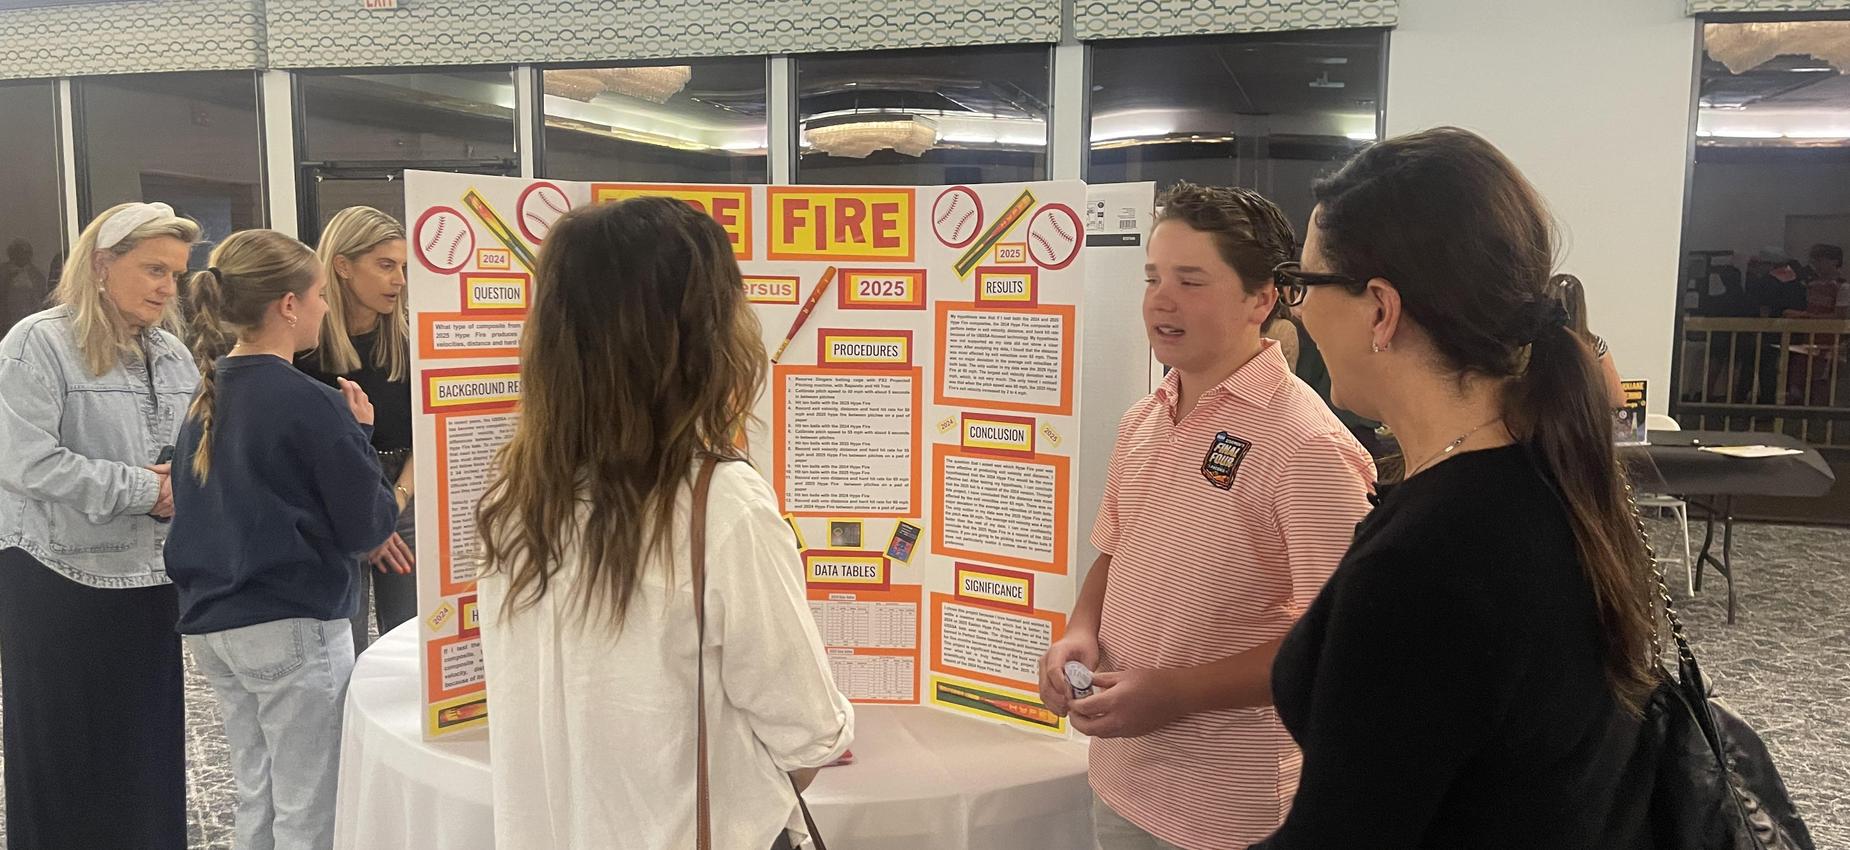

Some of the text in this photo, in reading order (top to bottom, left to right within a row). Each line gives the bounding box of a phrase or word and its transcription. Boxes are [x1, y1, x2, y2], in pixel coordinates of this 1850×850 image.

[782, 198, 900, 250] FIRE
[483, 254, 504, 264] 2024
[1000, 249, 1020, 258] 2025
[474, 286, 520, 300] QUESTION
[743, 283, 792, 296] ersus
[860, 280, 904, 296] 2025
[986, 280, 1023, 294] RESULTS
[834, 344, 898, 357] PROCEDURES
[439, 382, 504, 398] BACKGROUND
[940, 418, 954, 430] 2024
[970, 426, 1024, 442] CONCLUSION
[1044, 428, 1058, 442] 2025
[1214, 442, 1240, 458] FINAL
[1209, 452, 1234, 468] FOUR
[814, 564, 876, 578] DATA TABLES
[966, 578, 1022, 598] SIGNIFICANCE
[432, 607, 448, 625] 2024
